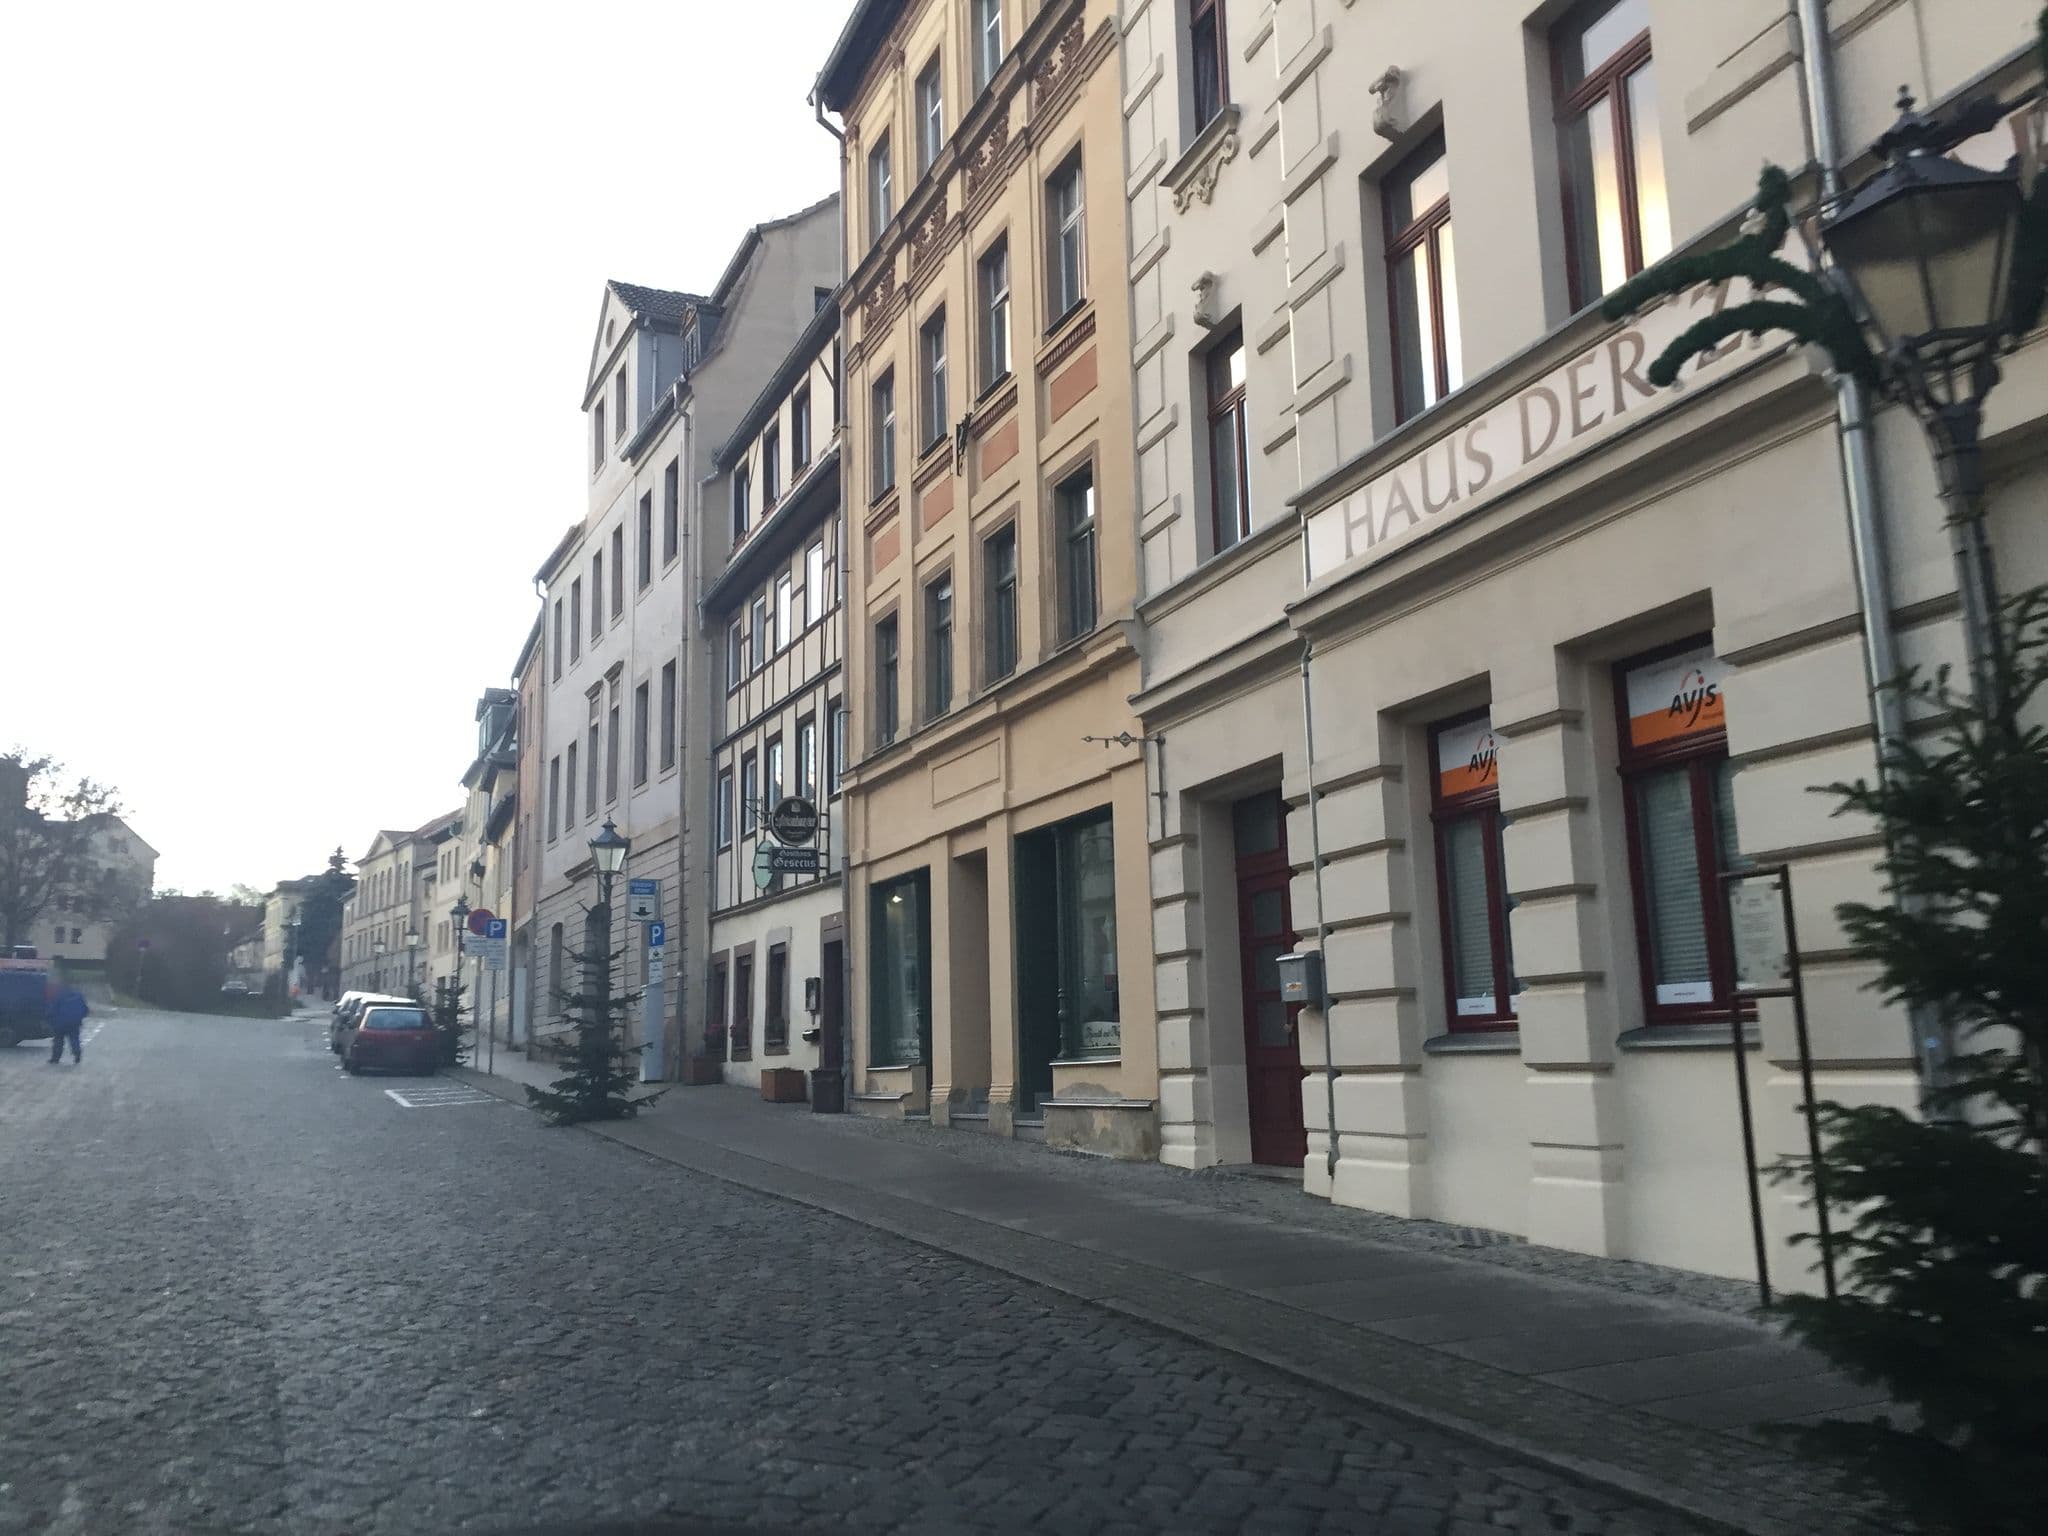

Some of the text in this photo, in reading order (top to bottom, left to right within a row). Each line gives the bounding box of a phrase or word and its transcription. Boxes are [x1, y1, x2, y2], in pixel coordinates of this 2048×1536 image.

[1343, 330, 1658, 560] HAUS DER
[490, 920, 503, 937] P
[651, 925, 662, 945] P
